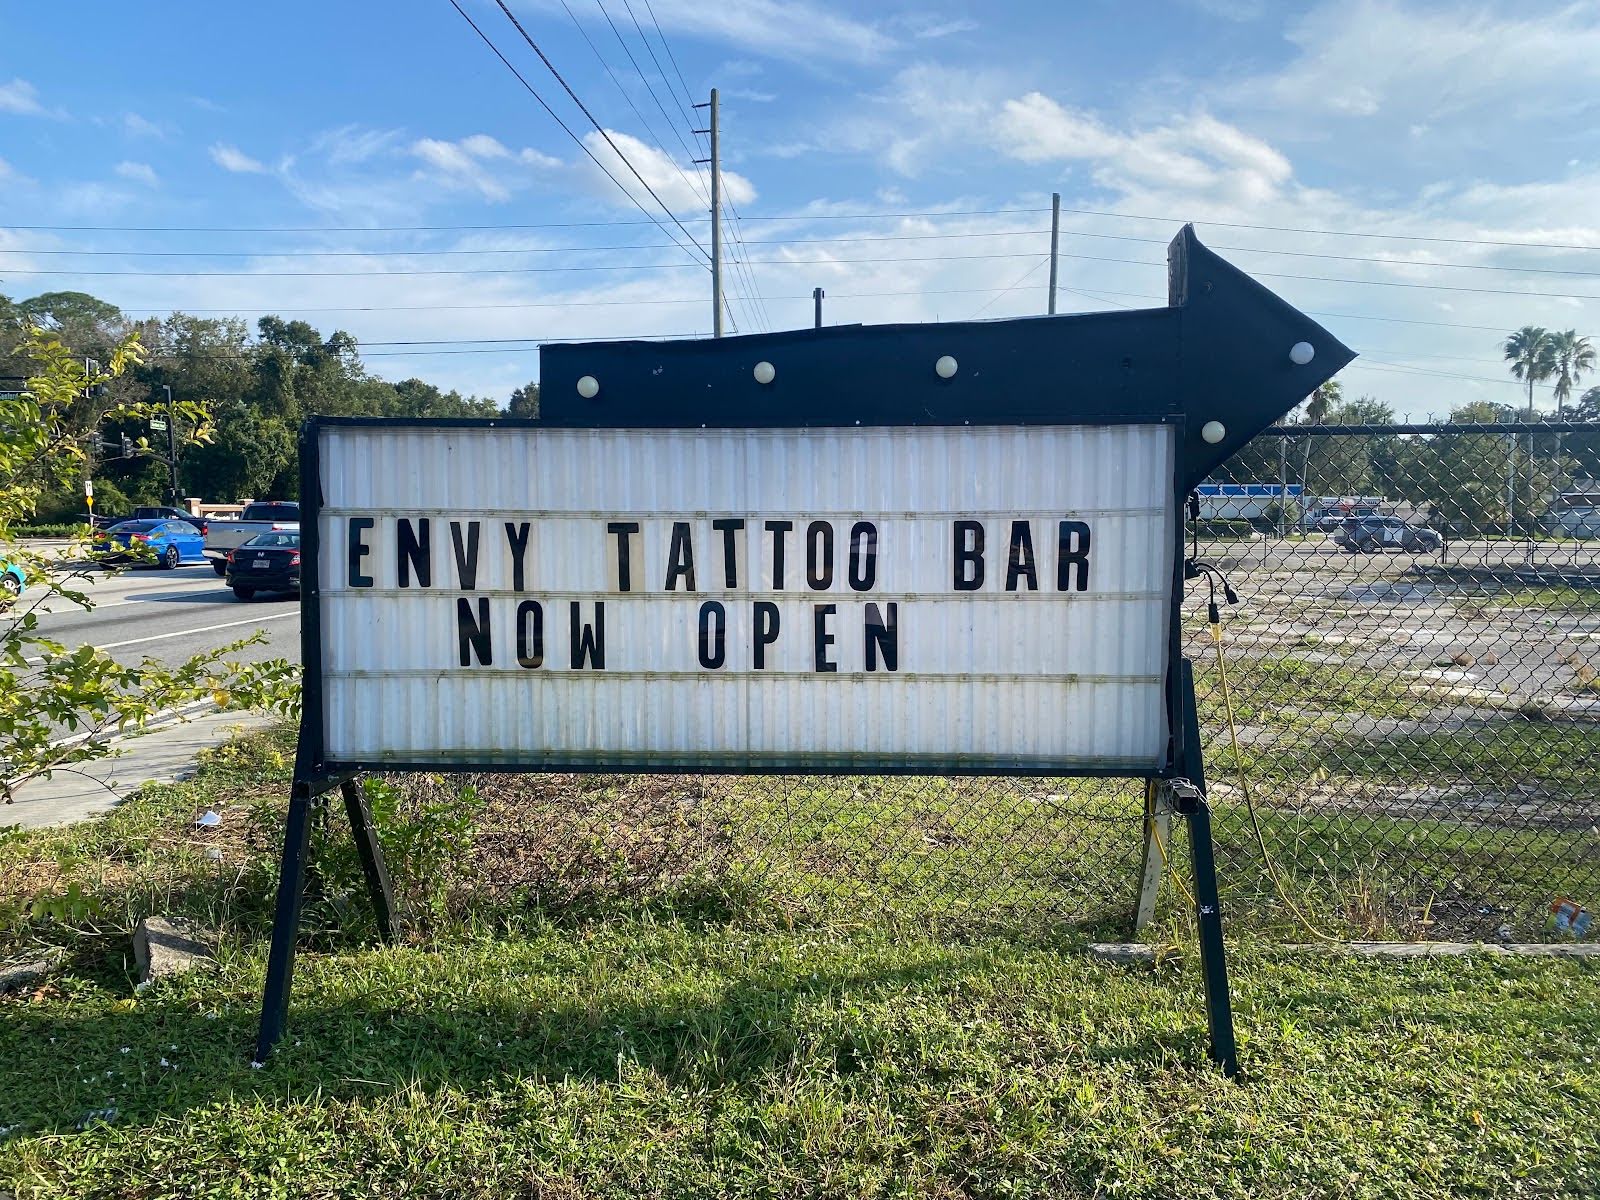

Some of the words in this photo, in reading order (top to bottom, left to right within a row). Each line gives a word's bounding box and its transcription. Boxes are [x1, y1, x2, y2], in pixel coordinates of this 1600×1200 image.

[348, 517, 531, 592] ENVY
[607, 518, 878, 592] TATTOO
[953, 520, 1091, 592] BAR
[457, 596, 606, 670] NOW
[698, 600, 898, 672] OPEN
